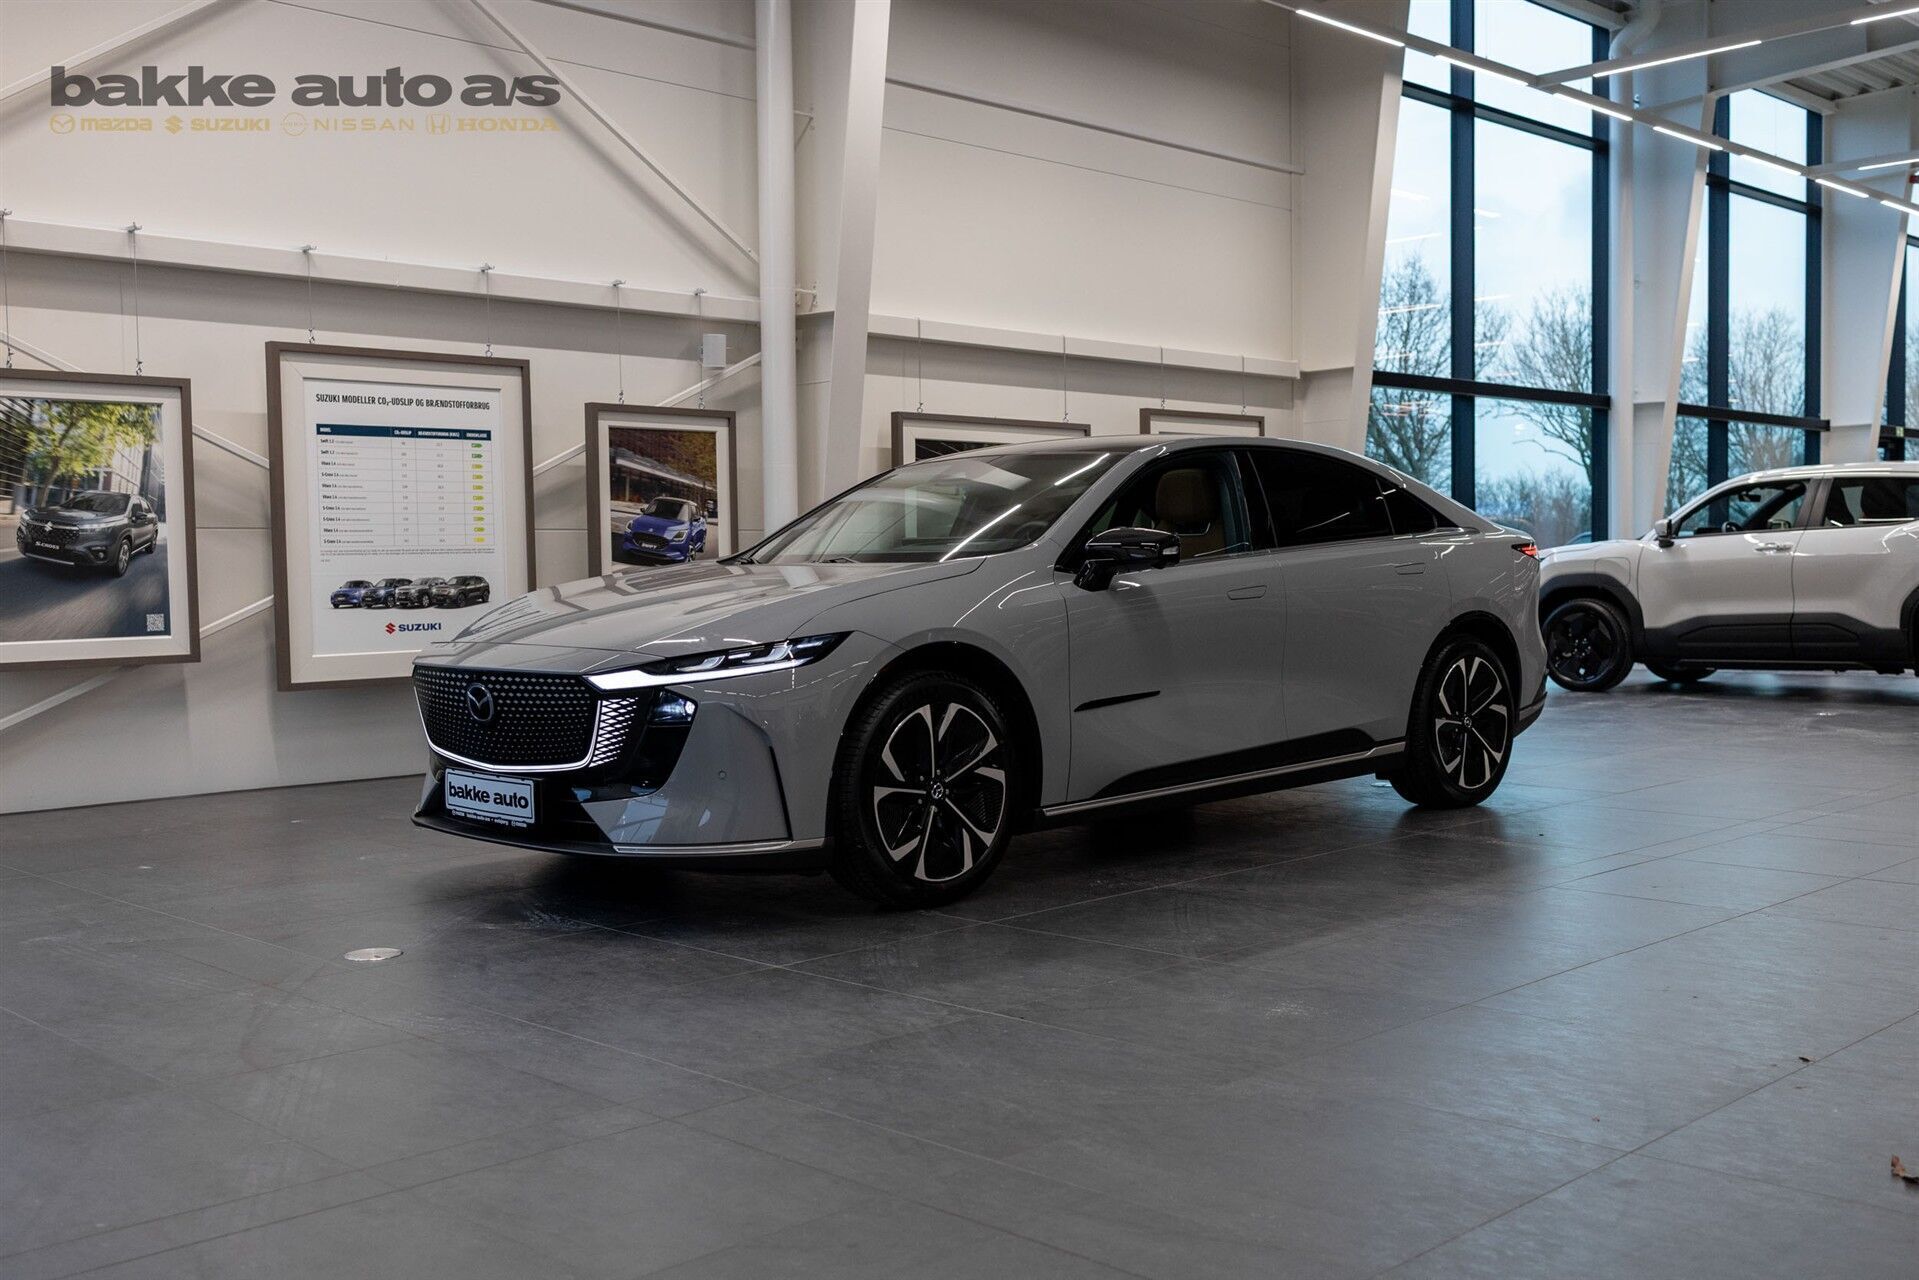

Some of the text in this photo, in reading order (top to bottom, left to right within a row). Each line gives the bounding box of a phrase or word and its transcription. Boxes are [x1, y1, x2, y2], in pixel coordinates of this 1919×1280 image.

[316, 393, 340, 403] SUZUKI
[342, 395, 376, 405] MODELLER
[415, 398, 424, 407] OG
[426, 399, 490, 410] BRÆNDSTOFFORBRUG
[398, 622, 442, 632] SUZUKI
[449, 781, 529, 809] bakke auto
